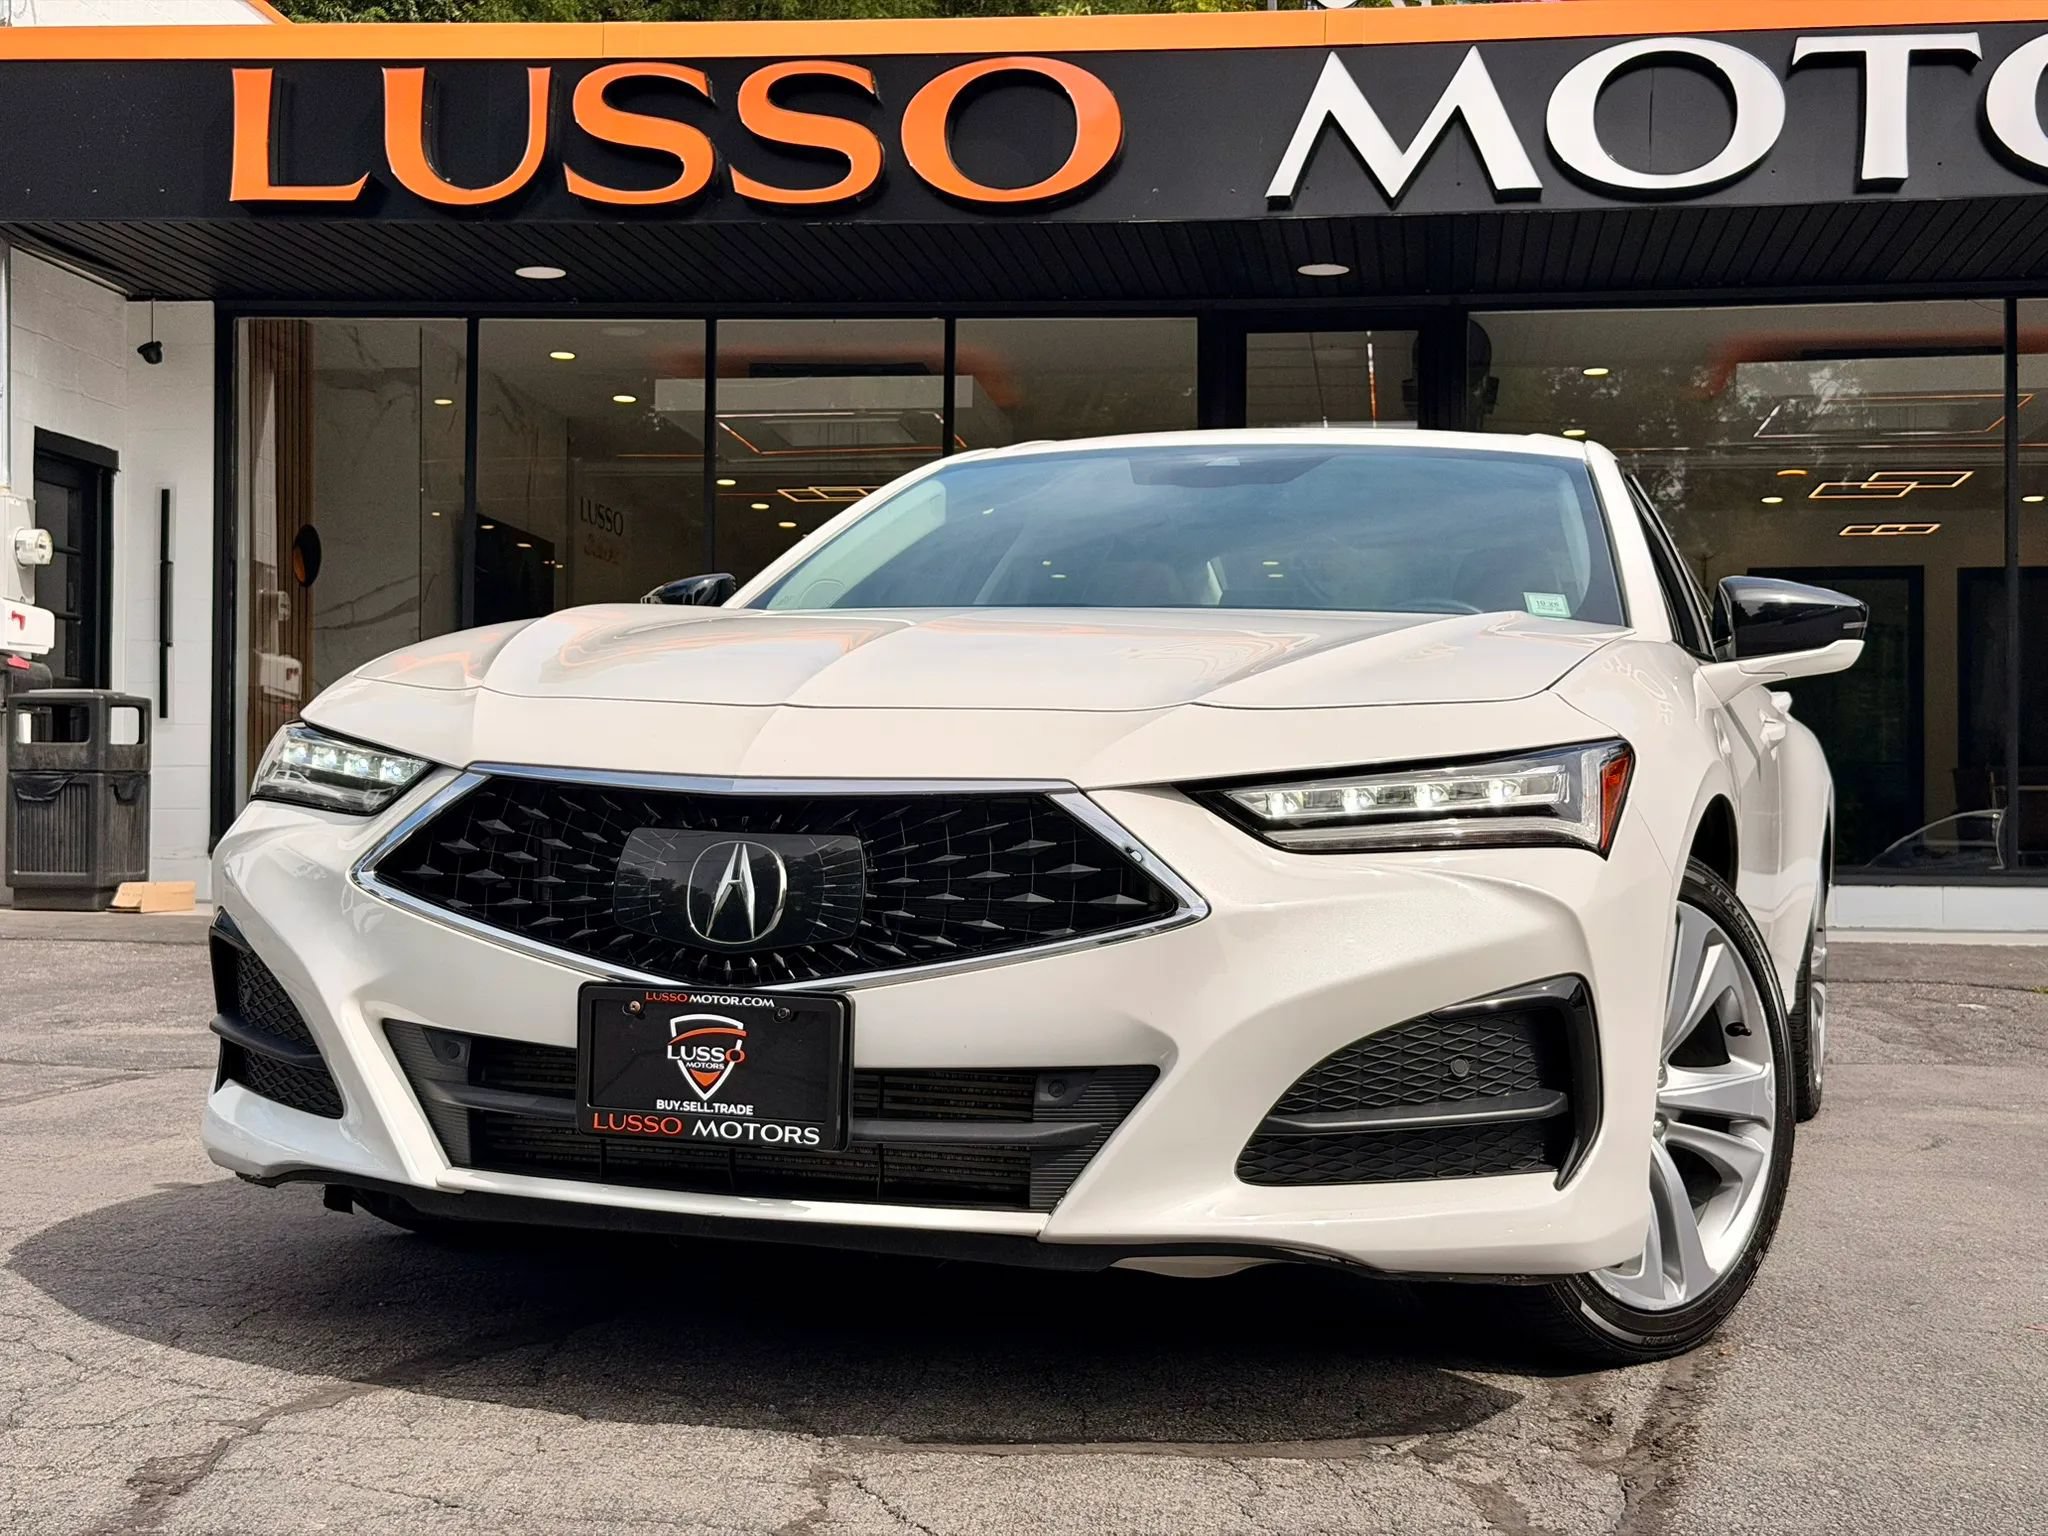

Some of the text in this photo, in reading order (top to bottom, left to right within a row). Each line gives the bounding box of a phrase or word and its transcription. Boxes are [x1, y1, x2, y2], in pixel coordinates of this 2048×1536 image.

[229, 32, 2048, 206] LUSSO MOT
[579, 495, 625, 537] LUSSO
[667, 1045, 746, 1063] LUSSO
[686, 1061, 725, 1070] MOTORS
[656, 1099, 754, 1115] BUY.SELL.TRADE
[593, 1113, 820, 1145] LUSSO MOTORS
